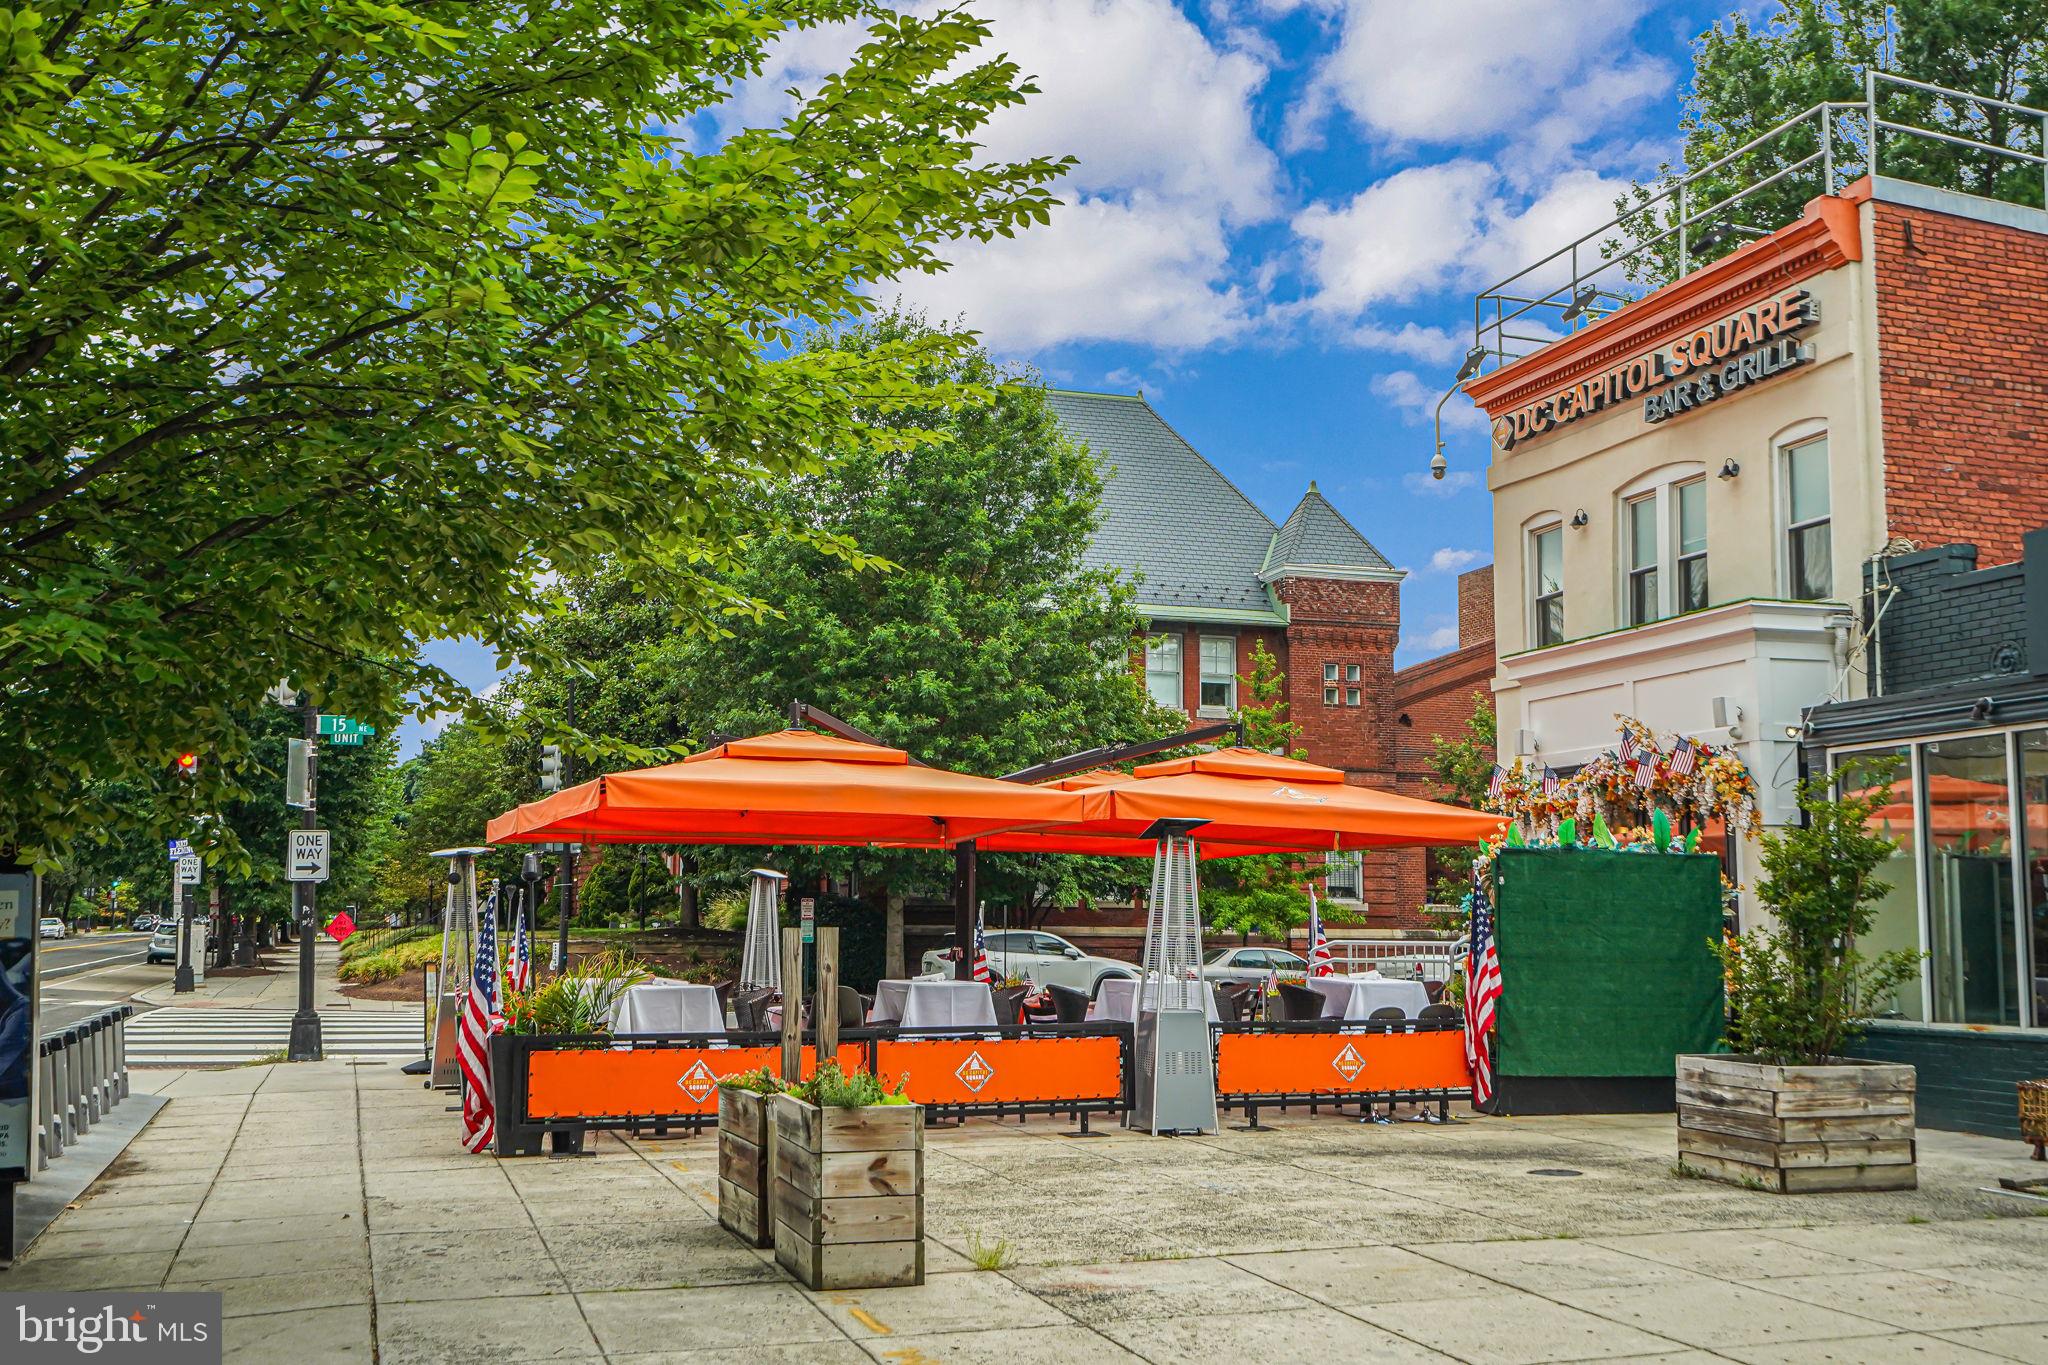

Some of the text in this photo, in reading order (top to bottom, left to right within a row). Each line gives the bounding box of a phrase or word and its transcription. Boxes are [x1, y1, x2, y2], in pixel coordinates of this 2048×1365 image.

[1514, 290, 1803, 440] DC CAPITOL SQUARE
[1644, 339, 1797, 424] BAR & GRILL
[332, 718, 347, 732] 15
[334, 734, 359, 743] UNIT
[296, 835, 322, 846] ONE
[296, 848, 323, 860] WAY
[181, 858, 198, 866] ONE
